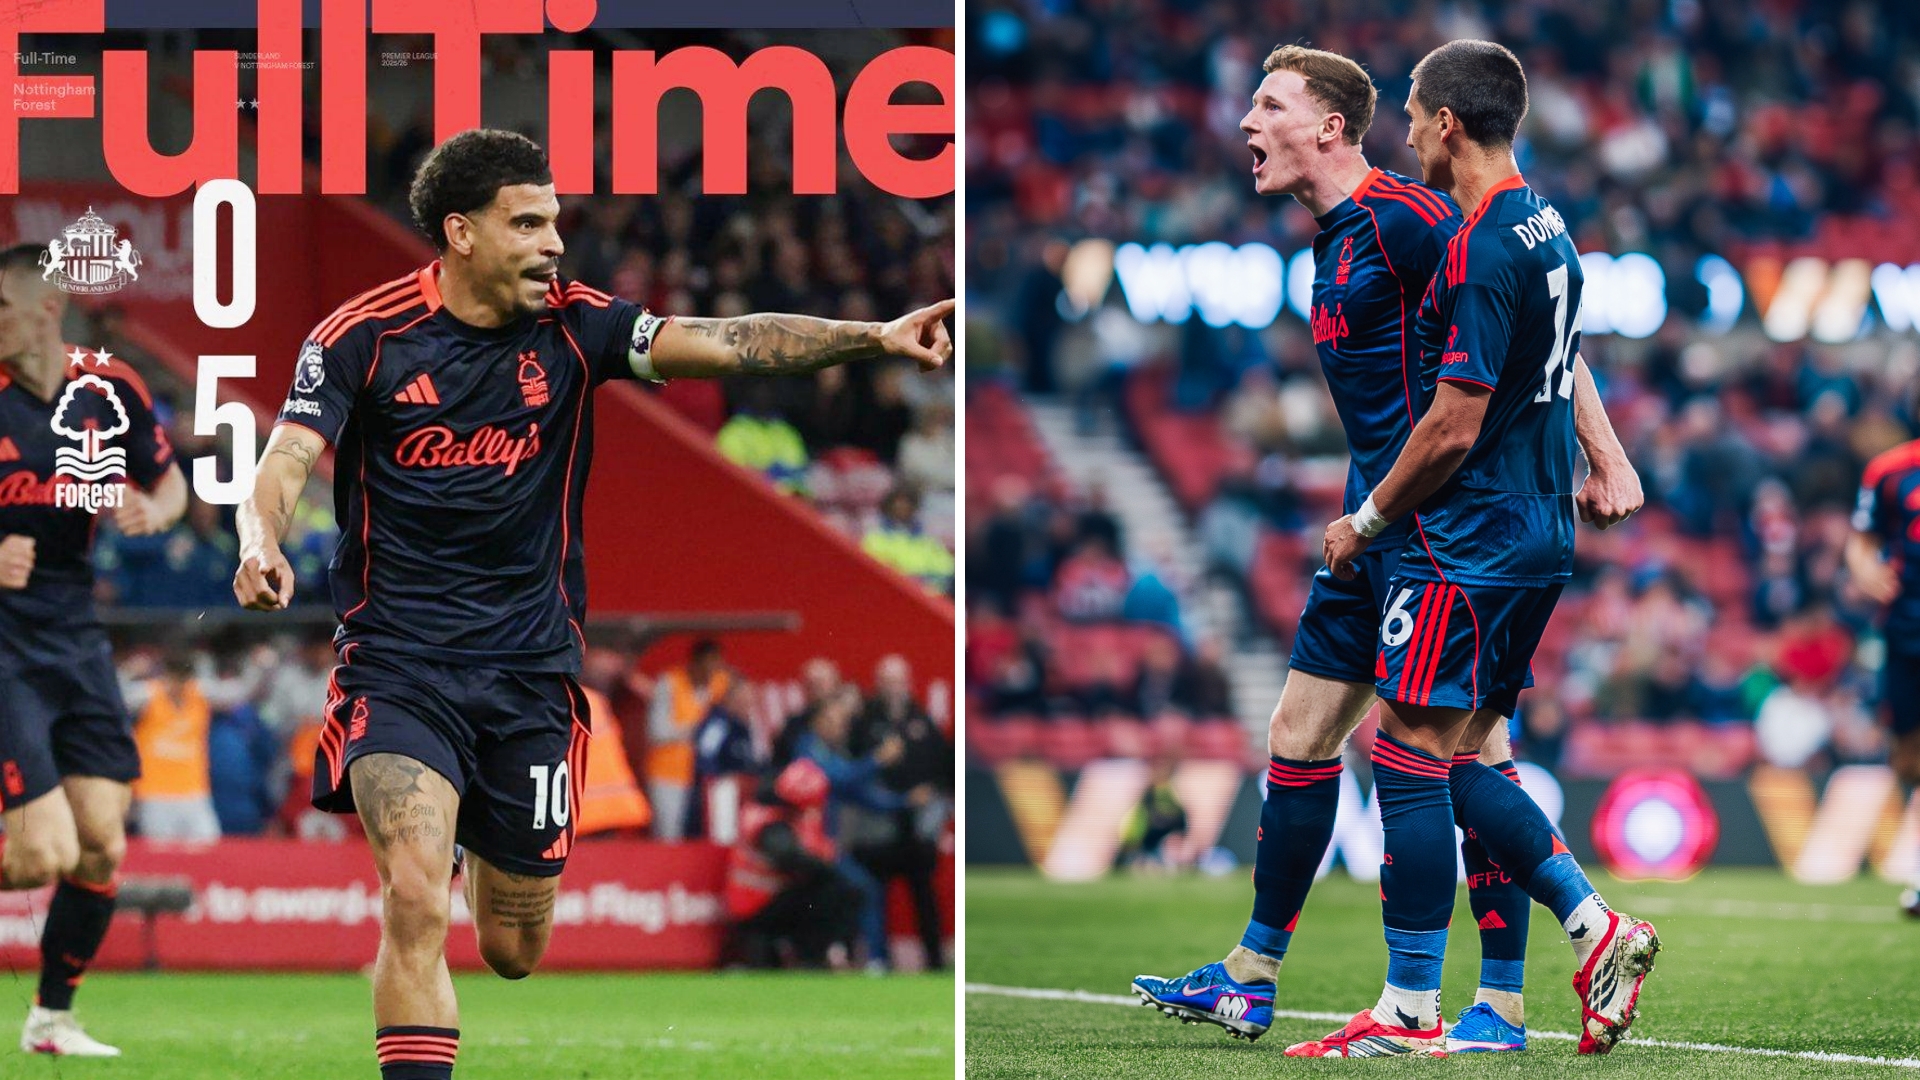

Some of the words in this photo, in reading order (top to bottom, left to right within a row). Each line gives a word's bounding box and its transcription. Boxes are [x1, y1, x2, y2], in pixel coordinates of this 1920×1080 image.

[395, 422, 541, 476] Bally's
[1379, 585, 1415, 647] 6
[529, 759, 570, 830] 10
